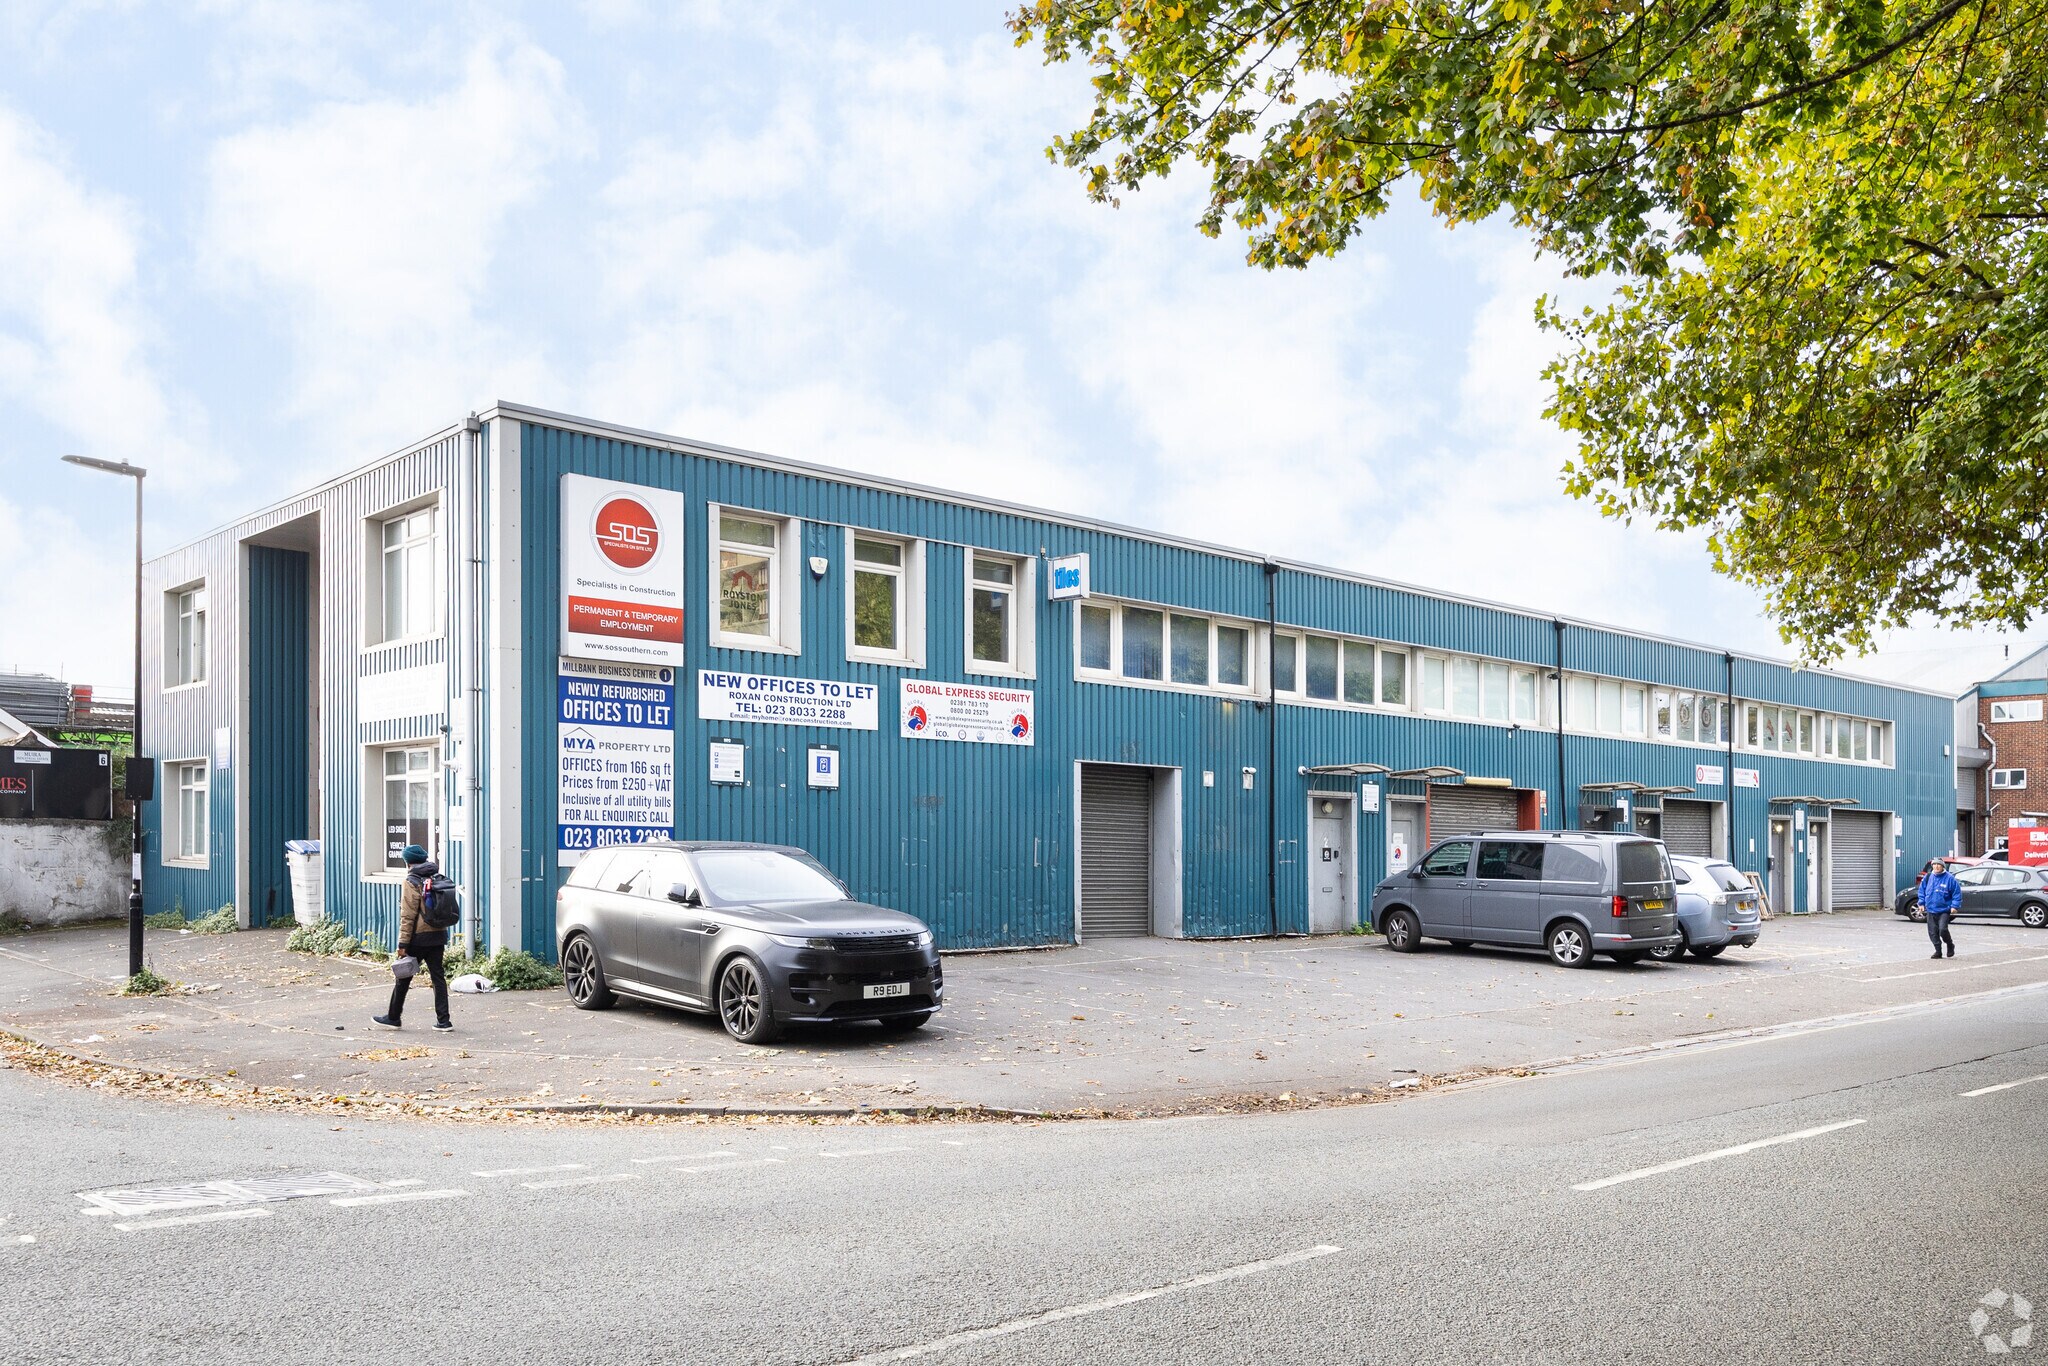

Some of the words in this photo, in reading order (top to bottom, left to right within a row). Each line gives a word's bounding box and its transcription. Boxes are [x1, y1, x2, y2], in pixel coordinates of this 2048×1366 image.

[609, 522, 650, 545] SOS
[604, 541, 629, 549] SPECIALISTS
[576, 578, 618, 590] Specialists
[620, 583, 627, 591] in
[629, 585, 676, 597] Construction
[723, 590, 763, 602] ROYSTON
[573, 604, 622, 617] PERMANENT
[624, 610, 630, 618] &
[631, 611, 679, 624] TEMPORARY
[729, 601, 757, 611] JONES
[600, 619, 654, 633] EMPLOYMENT
[584, 642, 669, 656] www.sossouthern.com
[562, 662, 597, 674] MILLBANK
[599, 666, 631, 677] BUSINESS
[632, 669, 657, 679] CENTRE
[568, 682, 600, 697] NEWLY
[602, 686, 666, 703] REFURBISHED
[704, 673, 742, 688] NEW
[747, 677, 816, 695] OFFICES
[820, 683, 841, 697] TO
[846, 686, 874, 700] LET
[906, 683, 943, 696] GLOBAL
[946, 687, 986, 700] EXPRESS
[988, 691, 1031, 703] SECURITY
[729, 691, 760, 701] ROXAN
[763, 694, 833, 706] CONSTRUCTION
[836, 700, 852, 708] LTD
[563, 698, 621, 722] OFFICES
[625, 704, 643, 723] TO
[647, 705, 671, 725] LET
[736, 703, 762, 713] TEL:
[765, 704, 786, 715] 023
[789, 706, 816, 717] 8033
[819, 708, 846, 719] 2288
[563, 737, 595, 750] MYA
[599, 741, 650, 752] PROPERTY
[653, 744, 671, 753] LTD
[562, 757, 603, 772] OFFICES
[605, 760, 628, 773] from
[630, 761, 647, 775] 166
[650, 764, 660, 777] sq
[663, 762, 671, 776] ft
[562, 775, 593, 789] Prices
[596, 777, 619, 790] from
[562, 793, 601, 806] Inclusive
[603, 795, 612, 806] of
[614, 795, 625, 807] all
[627, 795, 652, 809] utility
[654, 796, 671, 808] bills
[564, 809, 581, 821] FOR
[584, 810, 599, 821] ALL
[602, 810, 647, 823] ENQUIRIES
[649, 811, 670, 823] CALL
[564, 827, 592, 848] 023
[596, 828, 631, 847] 8033
[873, 986, 885, 997] R9
[886, 984, 903, 995] EDJ
